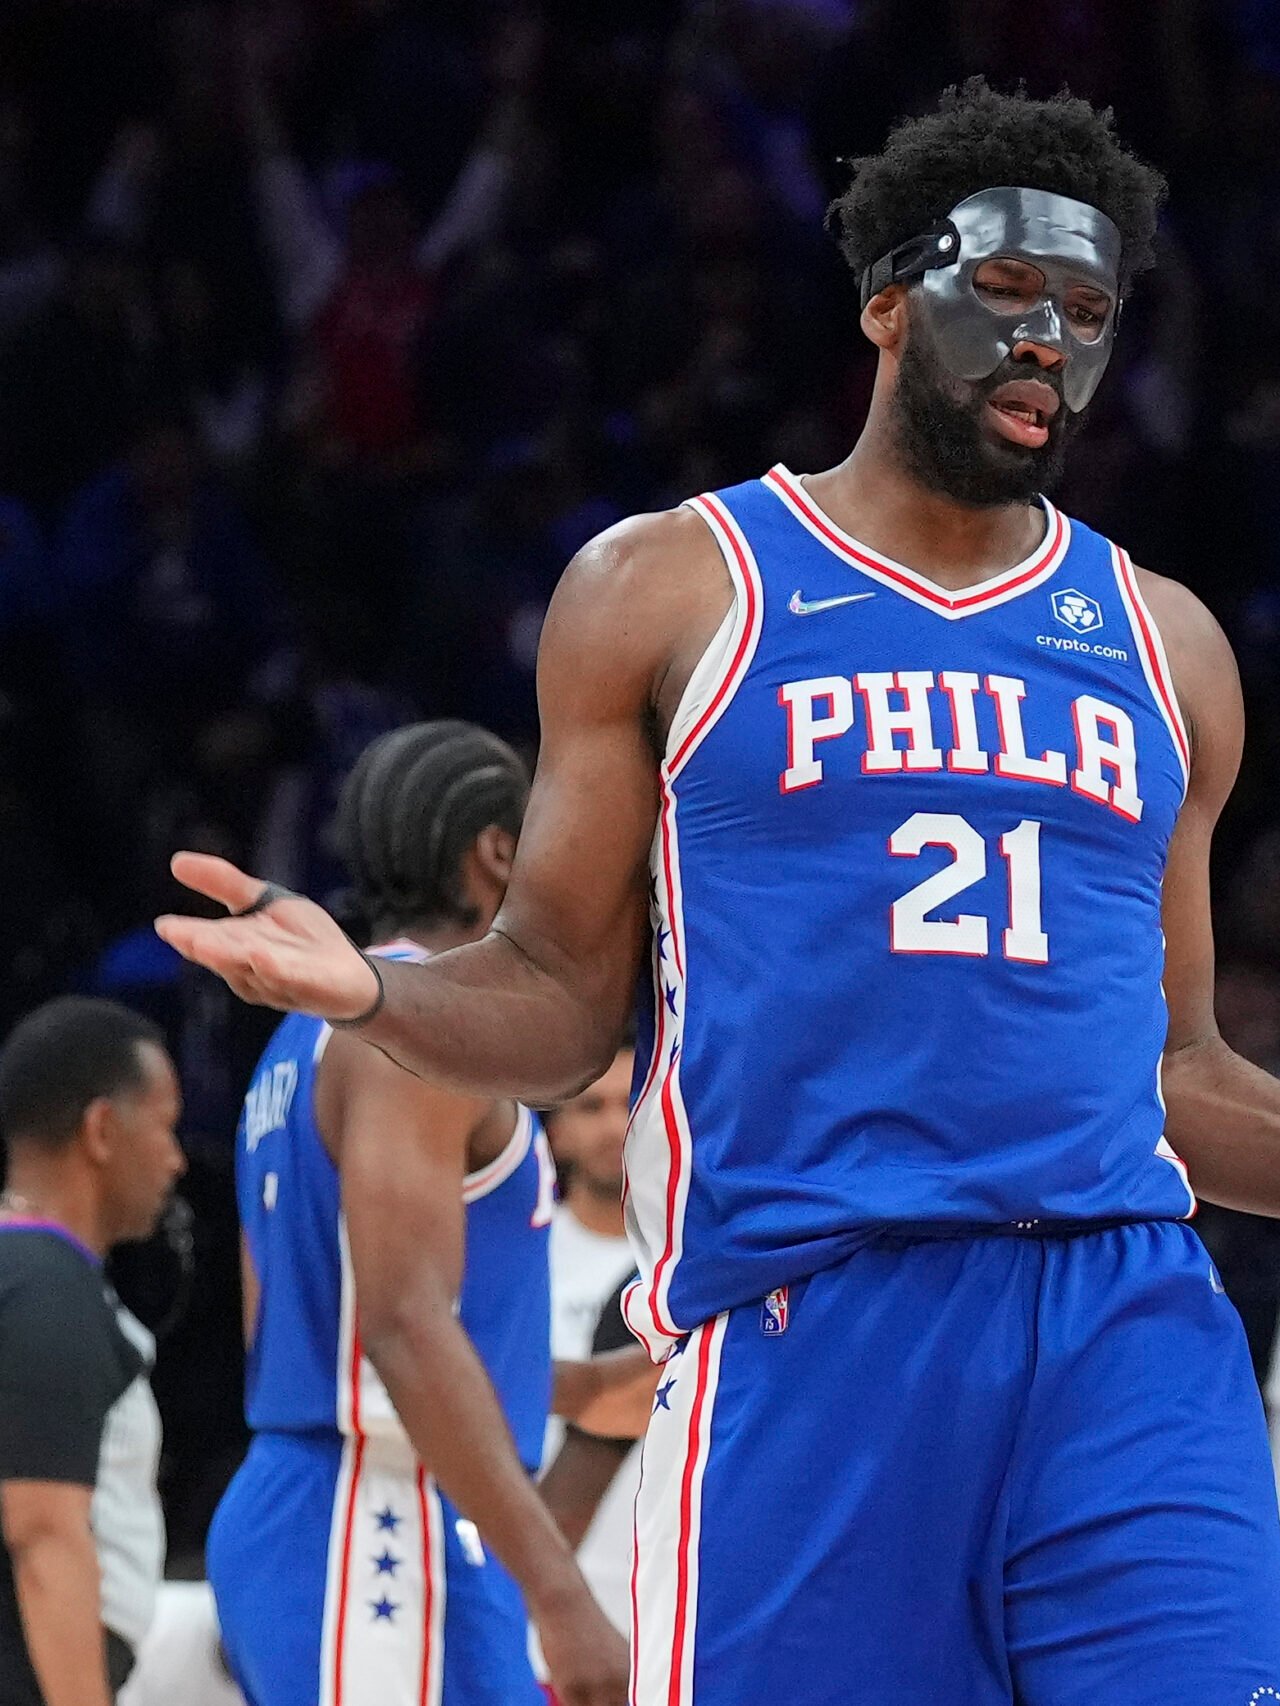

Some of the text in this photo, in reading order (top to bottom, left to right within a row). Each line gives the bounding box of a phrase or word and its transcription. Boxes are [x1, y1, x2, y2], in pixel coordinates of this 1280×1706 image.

[1036, 635, 1128, 661] crypto.com
[779, 670, 1144, 823] PHILA
[888, 812, 1049, 964] 21
